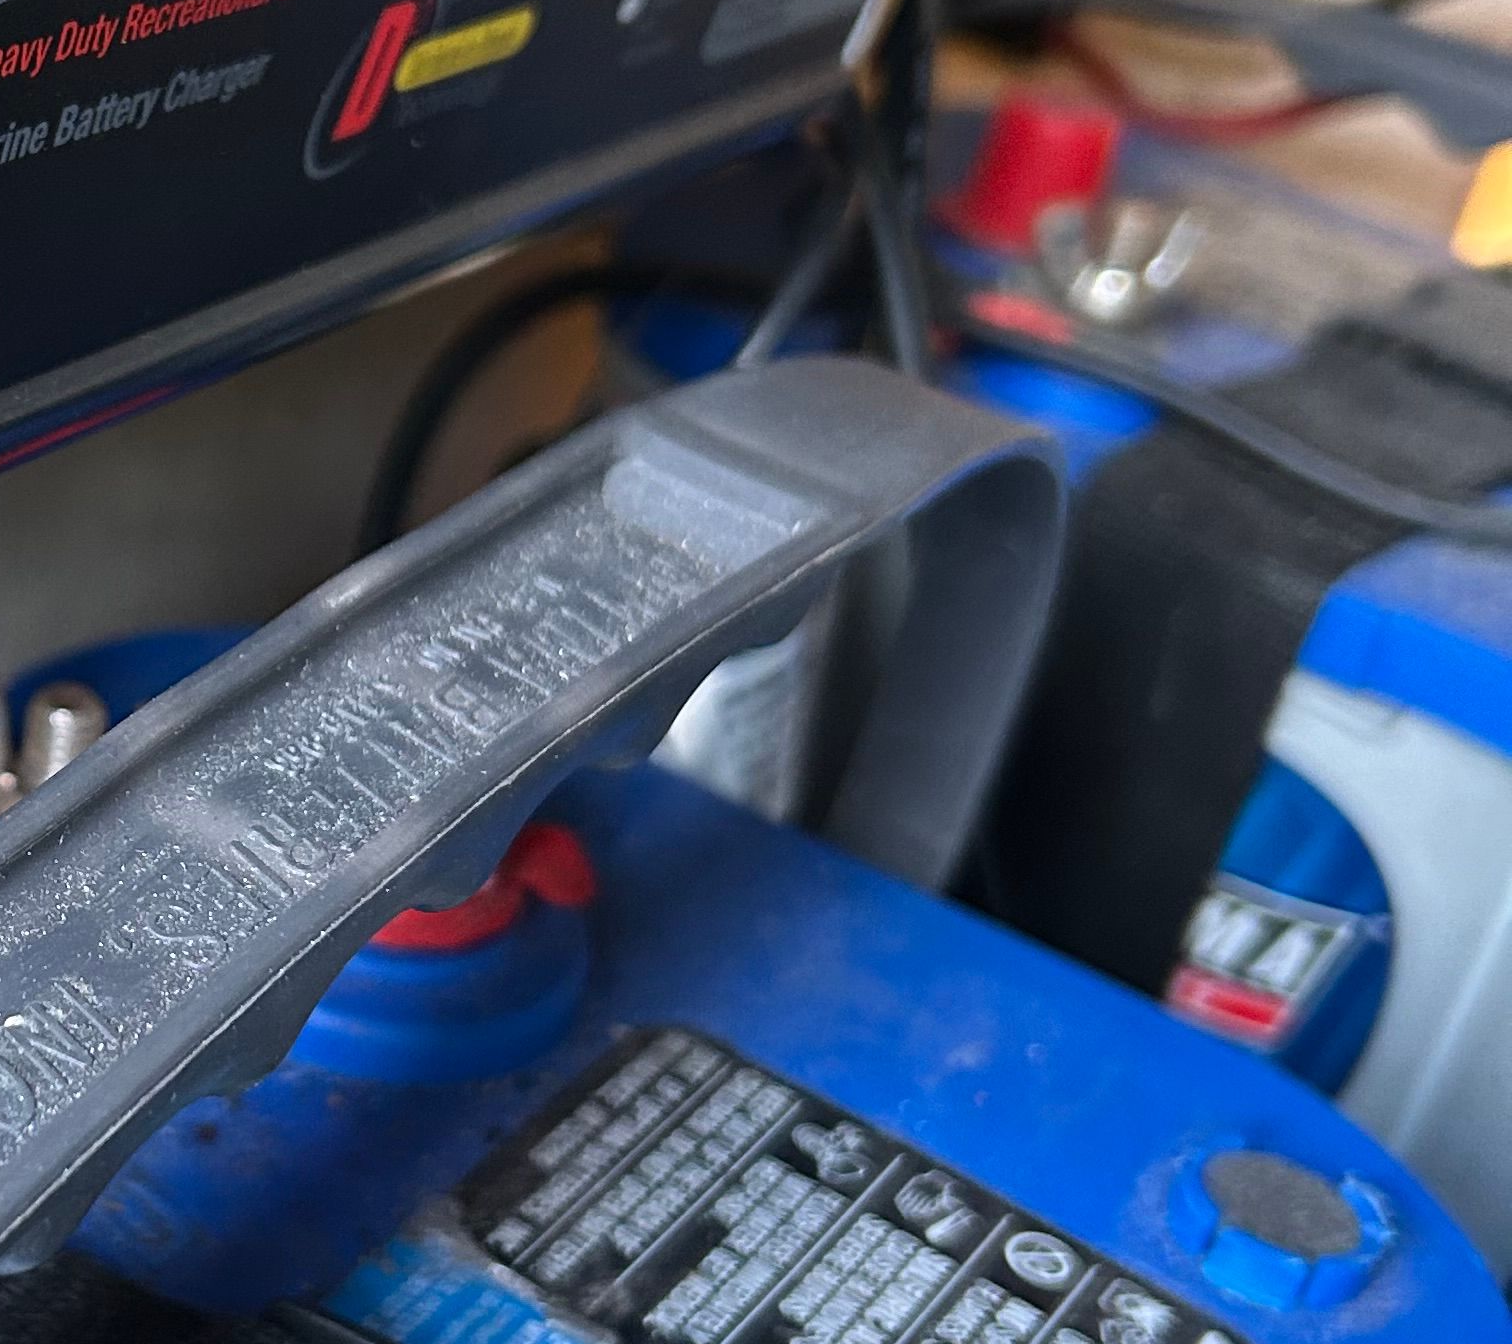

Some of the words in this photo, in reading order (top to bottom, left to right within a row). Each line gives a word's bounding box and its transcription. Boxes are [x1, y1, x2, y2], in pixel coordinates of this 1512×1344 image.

[55, 14, 120, 59] Duty
[54, 87, 157, 148] Battery
[163, 55, 274, 113] Charger
